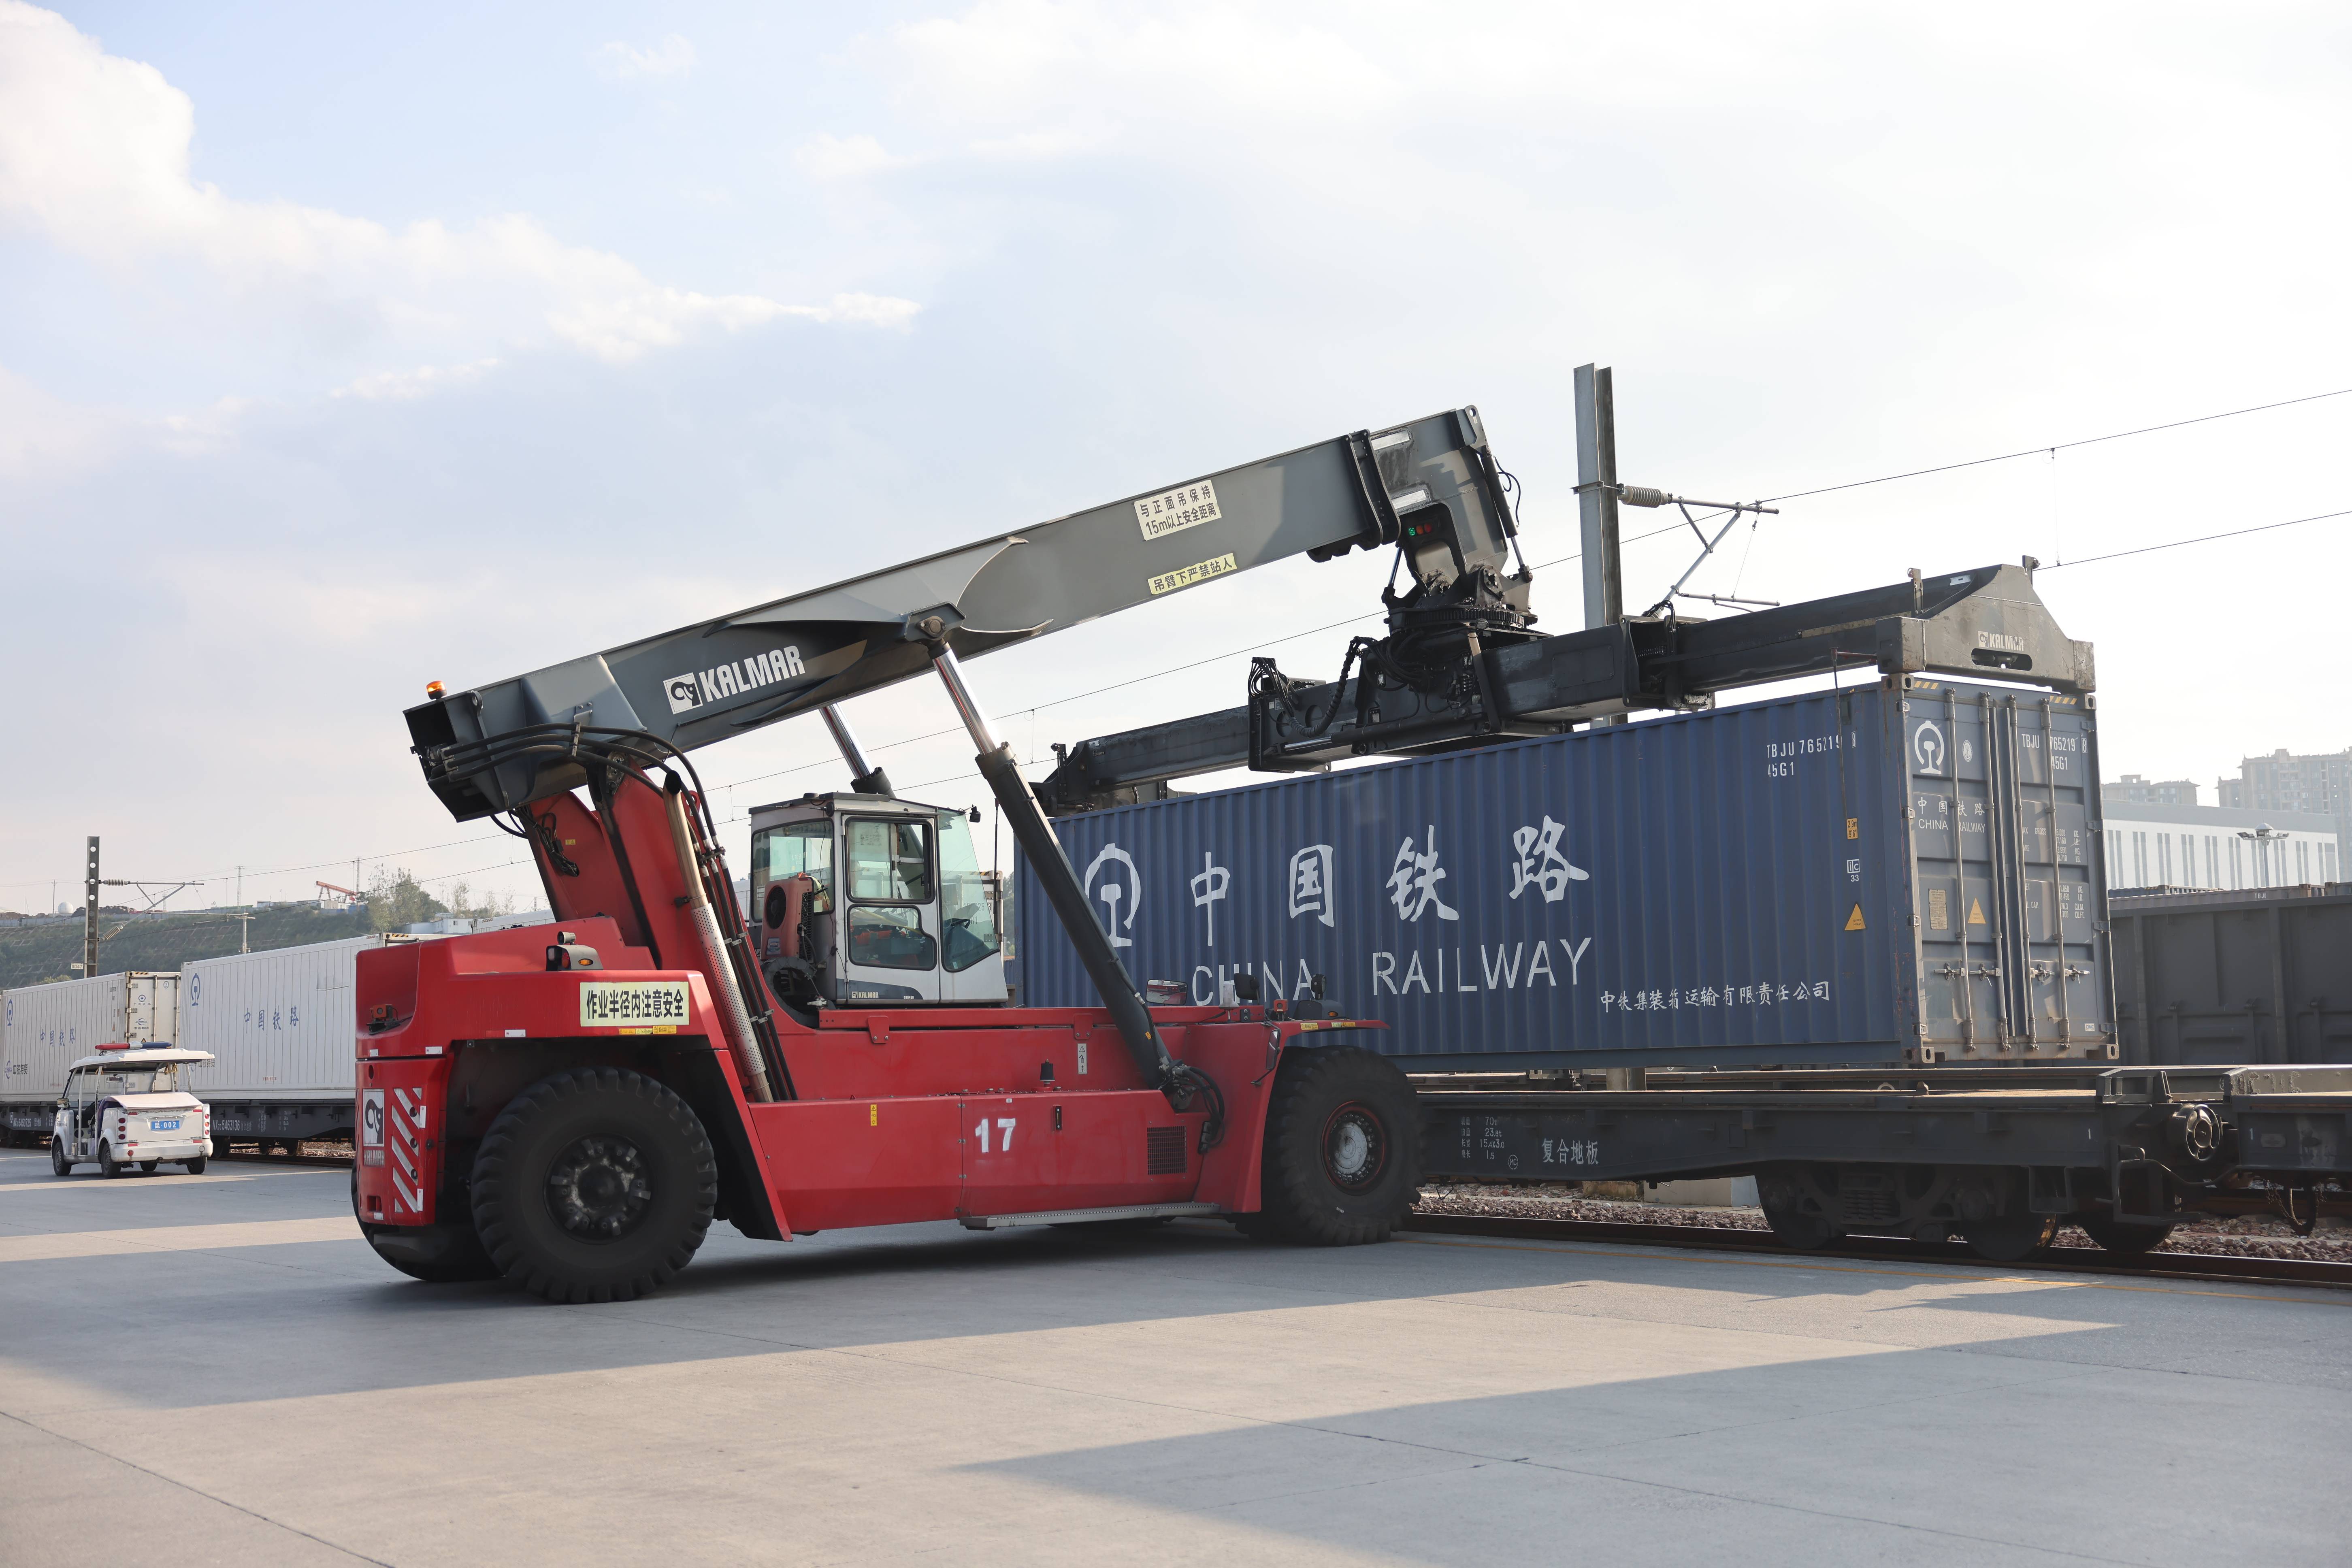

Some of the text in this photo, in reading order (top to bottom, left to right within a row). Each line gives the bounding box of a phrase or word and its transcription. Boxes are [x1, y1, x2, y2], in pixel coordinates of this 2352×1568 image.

[1140, 484, 1210, 518] 与正面吊保持
[1146, 502, 1216, 535] 15m以上安全距离
[1153, 557, 1232, 591] 吊臂下严禁站人
[1990, 633, 2024, 652] KALMAR
[699, 646, 806, 703] KALMAR
[1766, 732, 1856, 758] TBJU 765219 8
[2021, 733, 2087, 753] TBJU 765219 8
[1768, 761, 1794, 778] 45G1
[2051, 756, 2068, 770] 45G1
[1917, 797, 1985, 816] 中国铁路
[1918, 819, 1986, 833] CHINA RAILWAY
[1190, 814, 1589, 946] 中国铁路
[1372, 937, 1591, 996] RAILWAY
[586, 989, 684, 1019] 作业半径内注意安全
[1600, 981, 1829, 1013] 中铁集装箱运输有限责任公司
[244, 1005, 299, 1034] 中国铁路
[1461, 1127, 1502, 1137] 自重 23.8t
[1485, 1116, 1497, 1126] 70t
[975, 1118, 1016, 1153] 17
[1461, 1138, 1471, 1147] 长宽
[1487, 1150, 1495, 1159] 1.5
[1542, 1138, 1599, 1165] 复合地板
